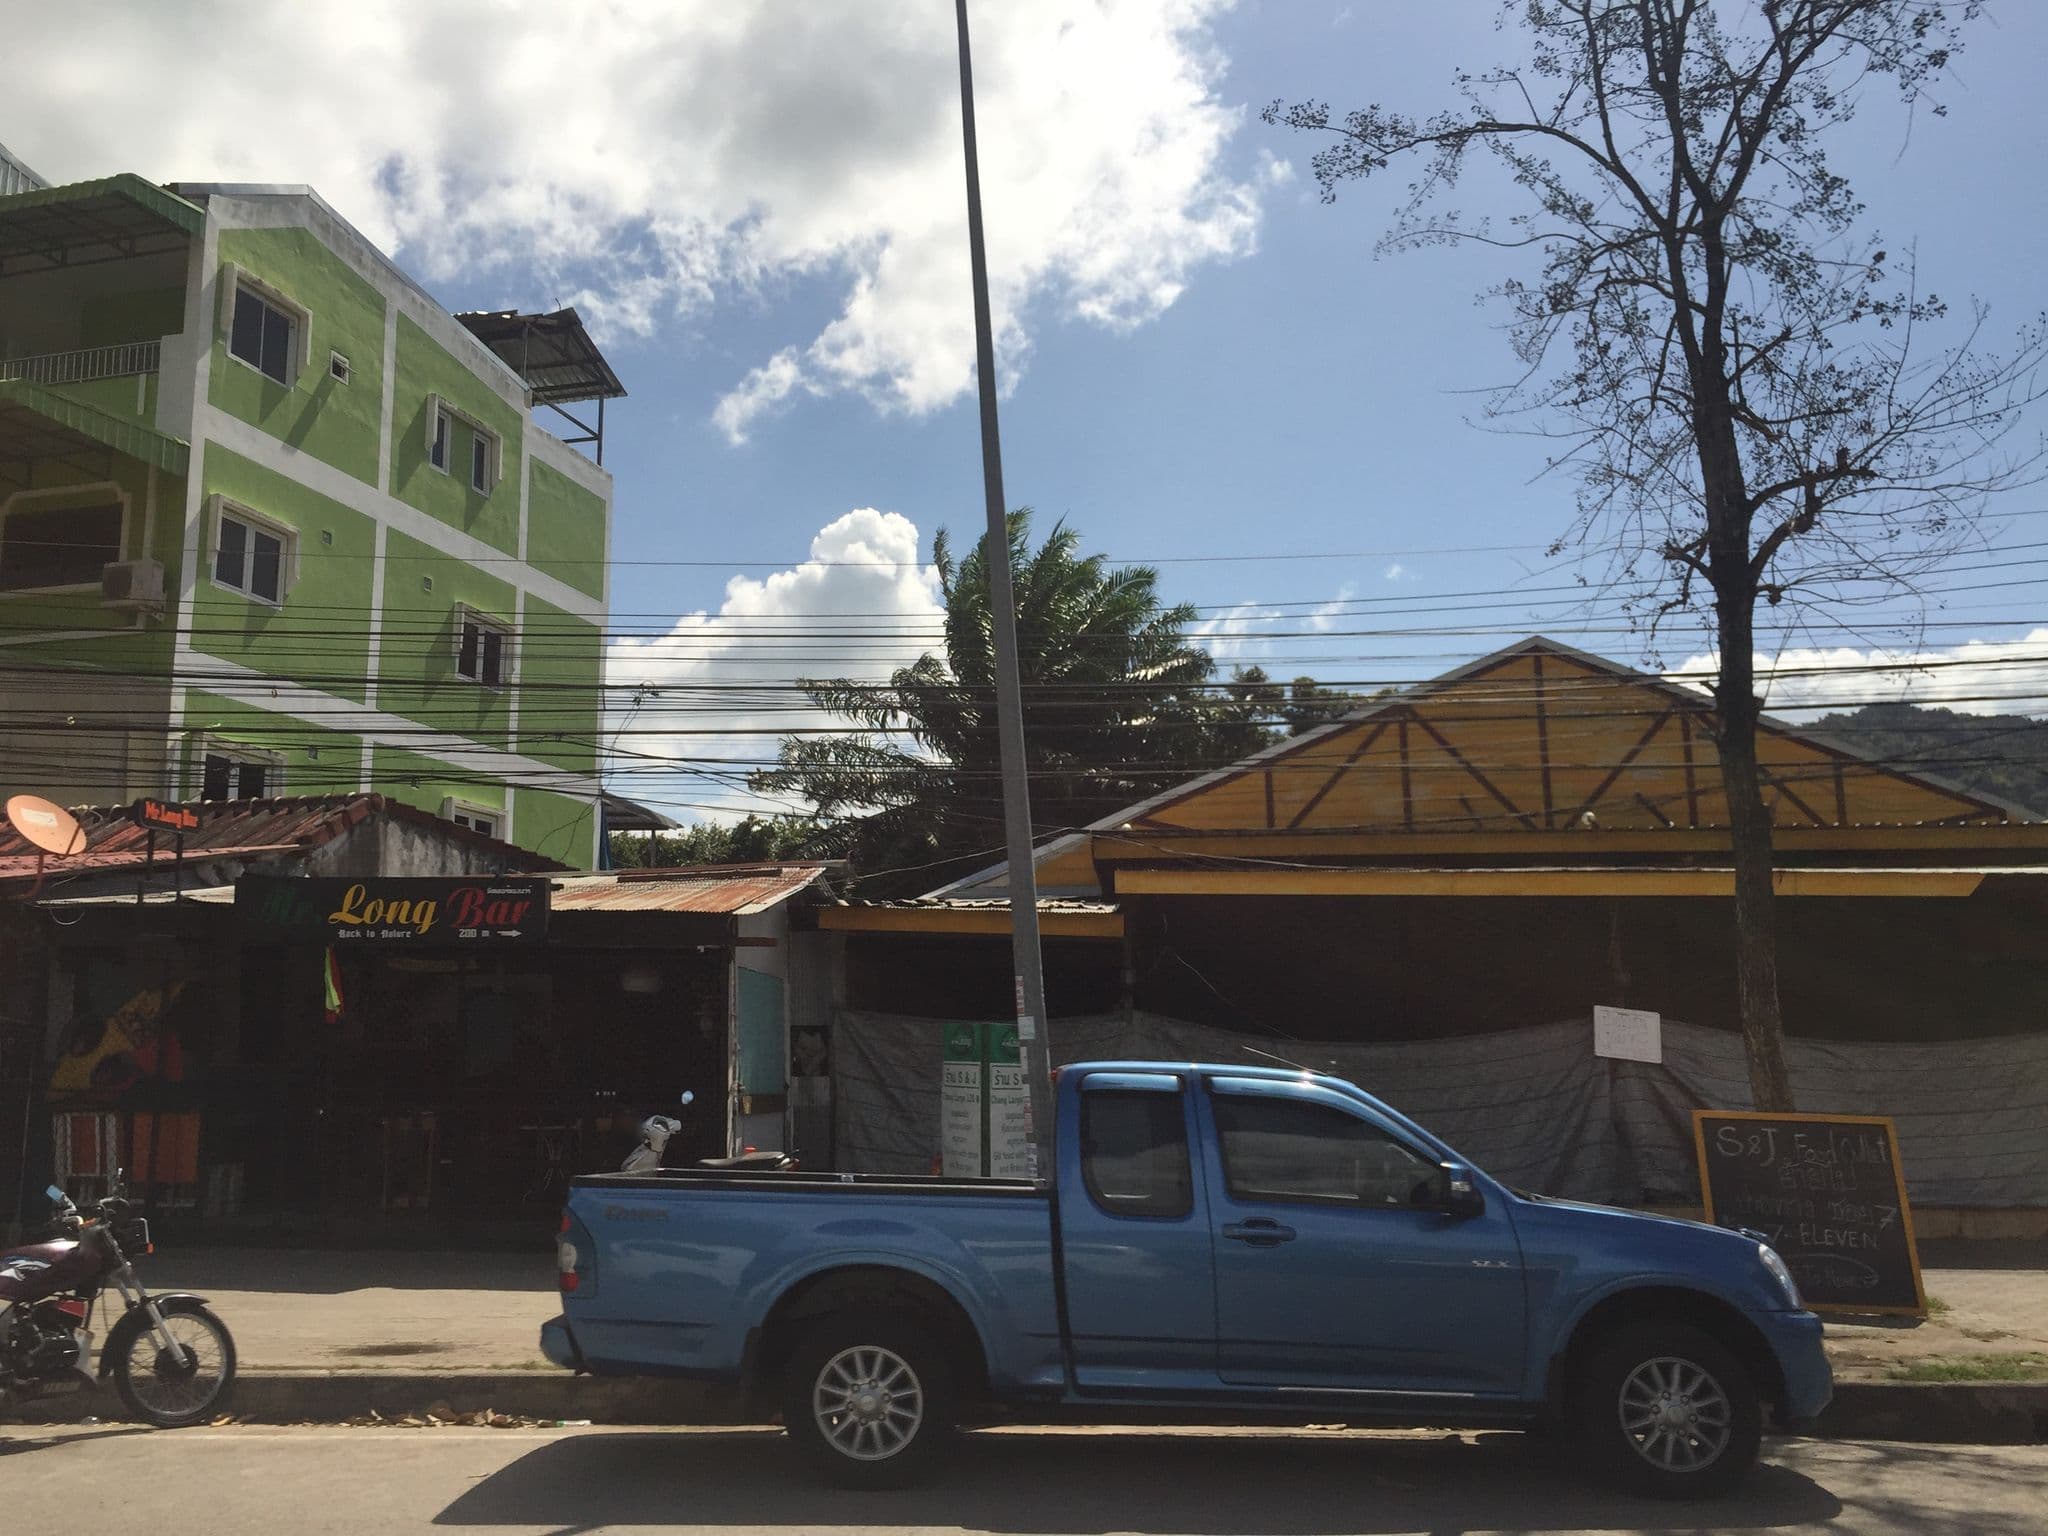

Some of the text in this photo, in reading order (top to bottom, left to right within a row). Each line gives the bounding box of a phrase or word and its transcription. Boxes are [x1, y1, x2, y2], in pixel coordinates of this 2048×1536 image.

[328, 883, 438, 935] Long
[446, 887, 531, 928] Bar
[458, 928, 478, 938] 200
[1716, 1126, 1776, 1167] S&J
